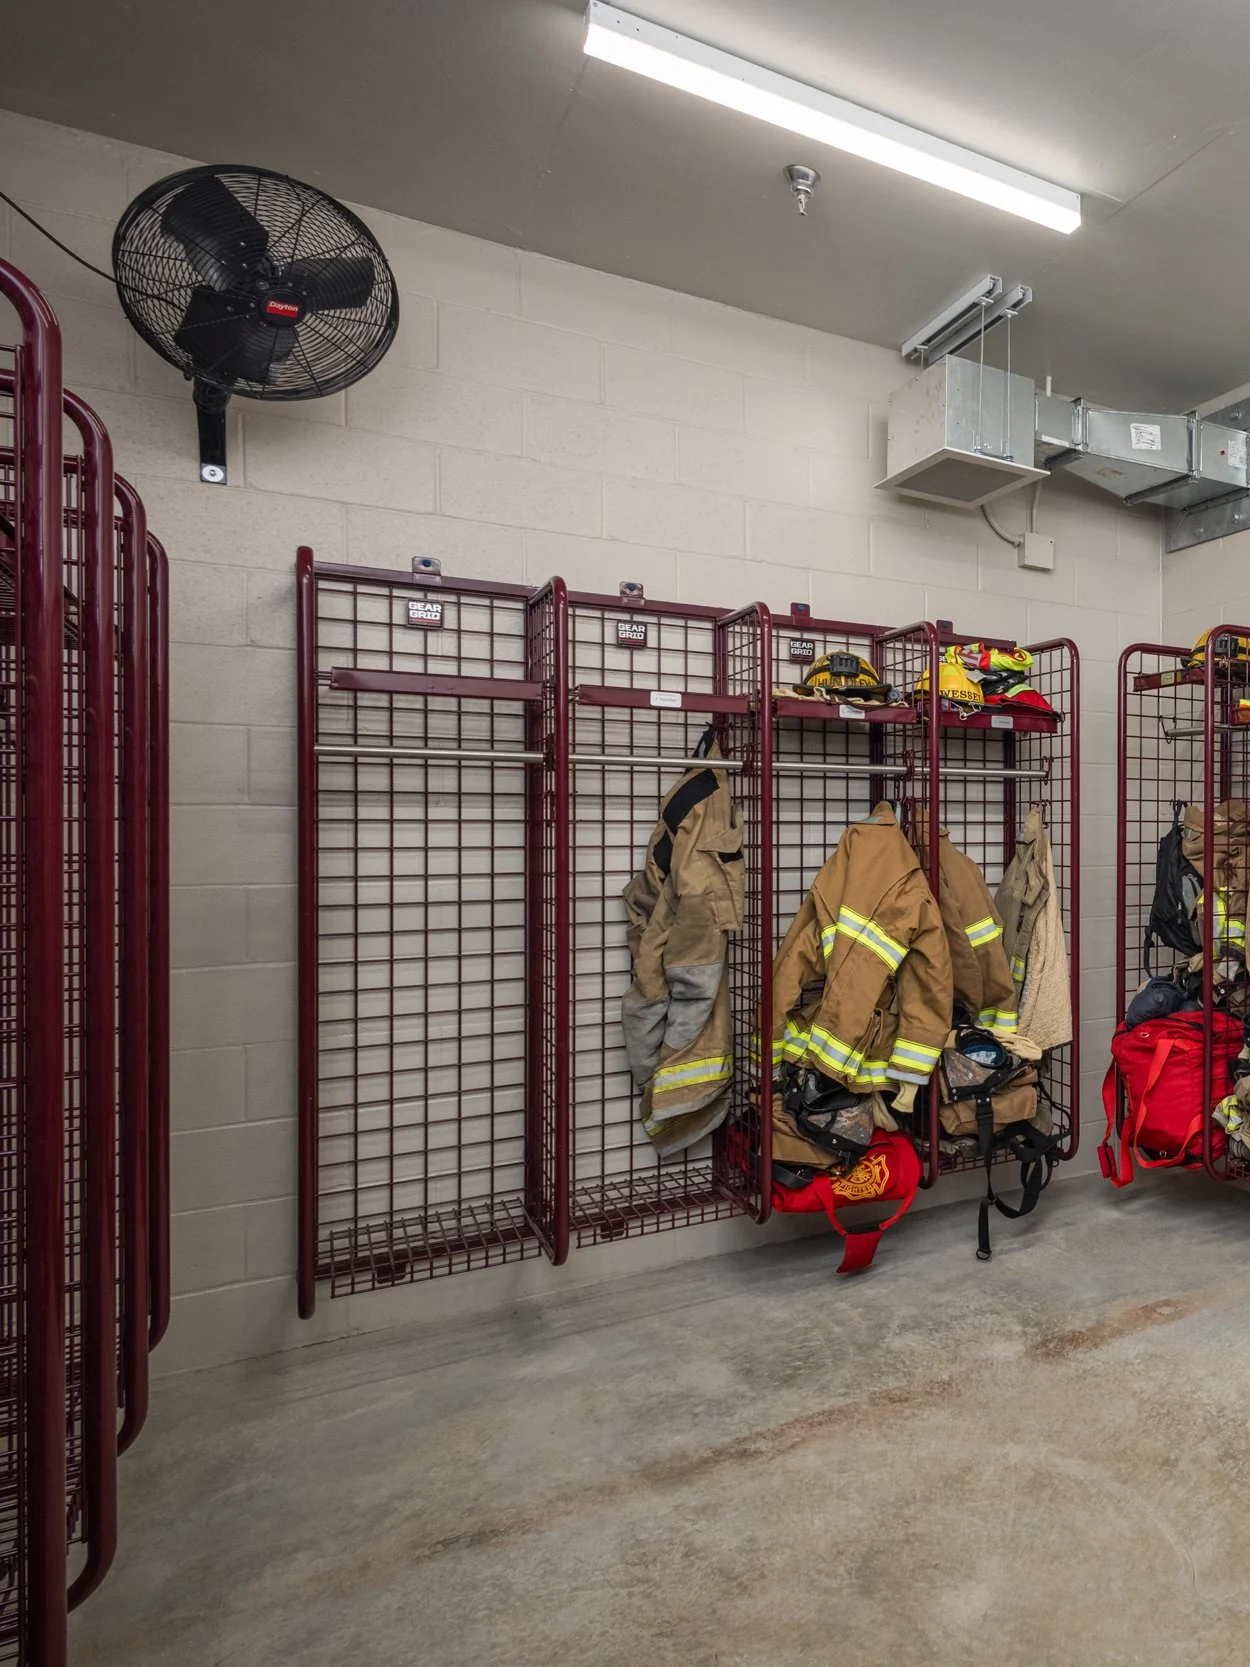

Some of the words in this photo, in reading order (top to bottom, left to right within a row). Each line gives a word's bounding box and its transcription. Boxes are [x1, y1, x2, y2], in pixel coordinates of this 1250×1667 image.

[270, 301, 298, 311] Dayton
[408, 602, 441, 612] GEAR
[410, 610, 440, 620] GRID
[618, 623, 645, 632] GEAR
[619, 631, 644, 639] GRID
[790, 641, 813, 649] GEAR
[791, 648, 812, 656] GRID
